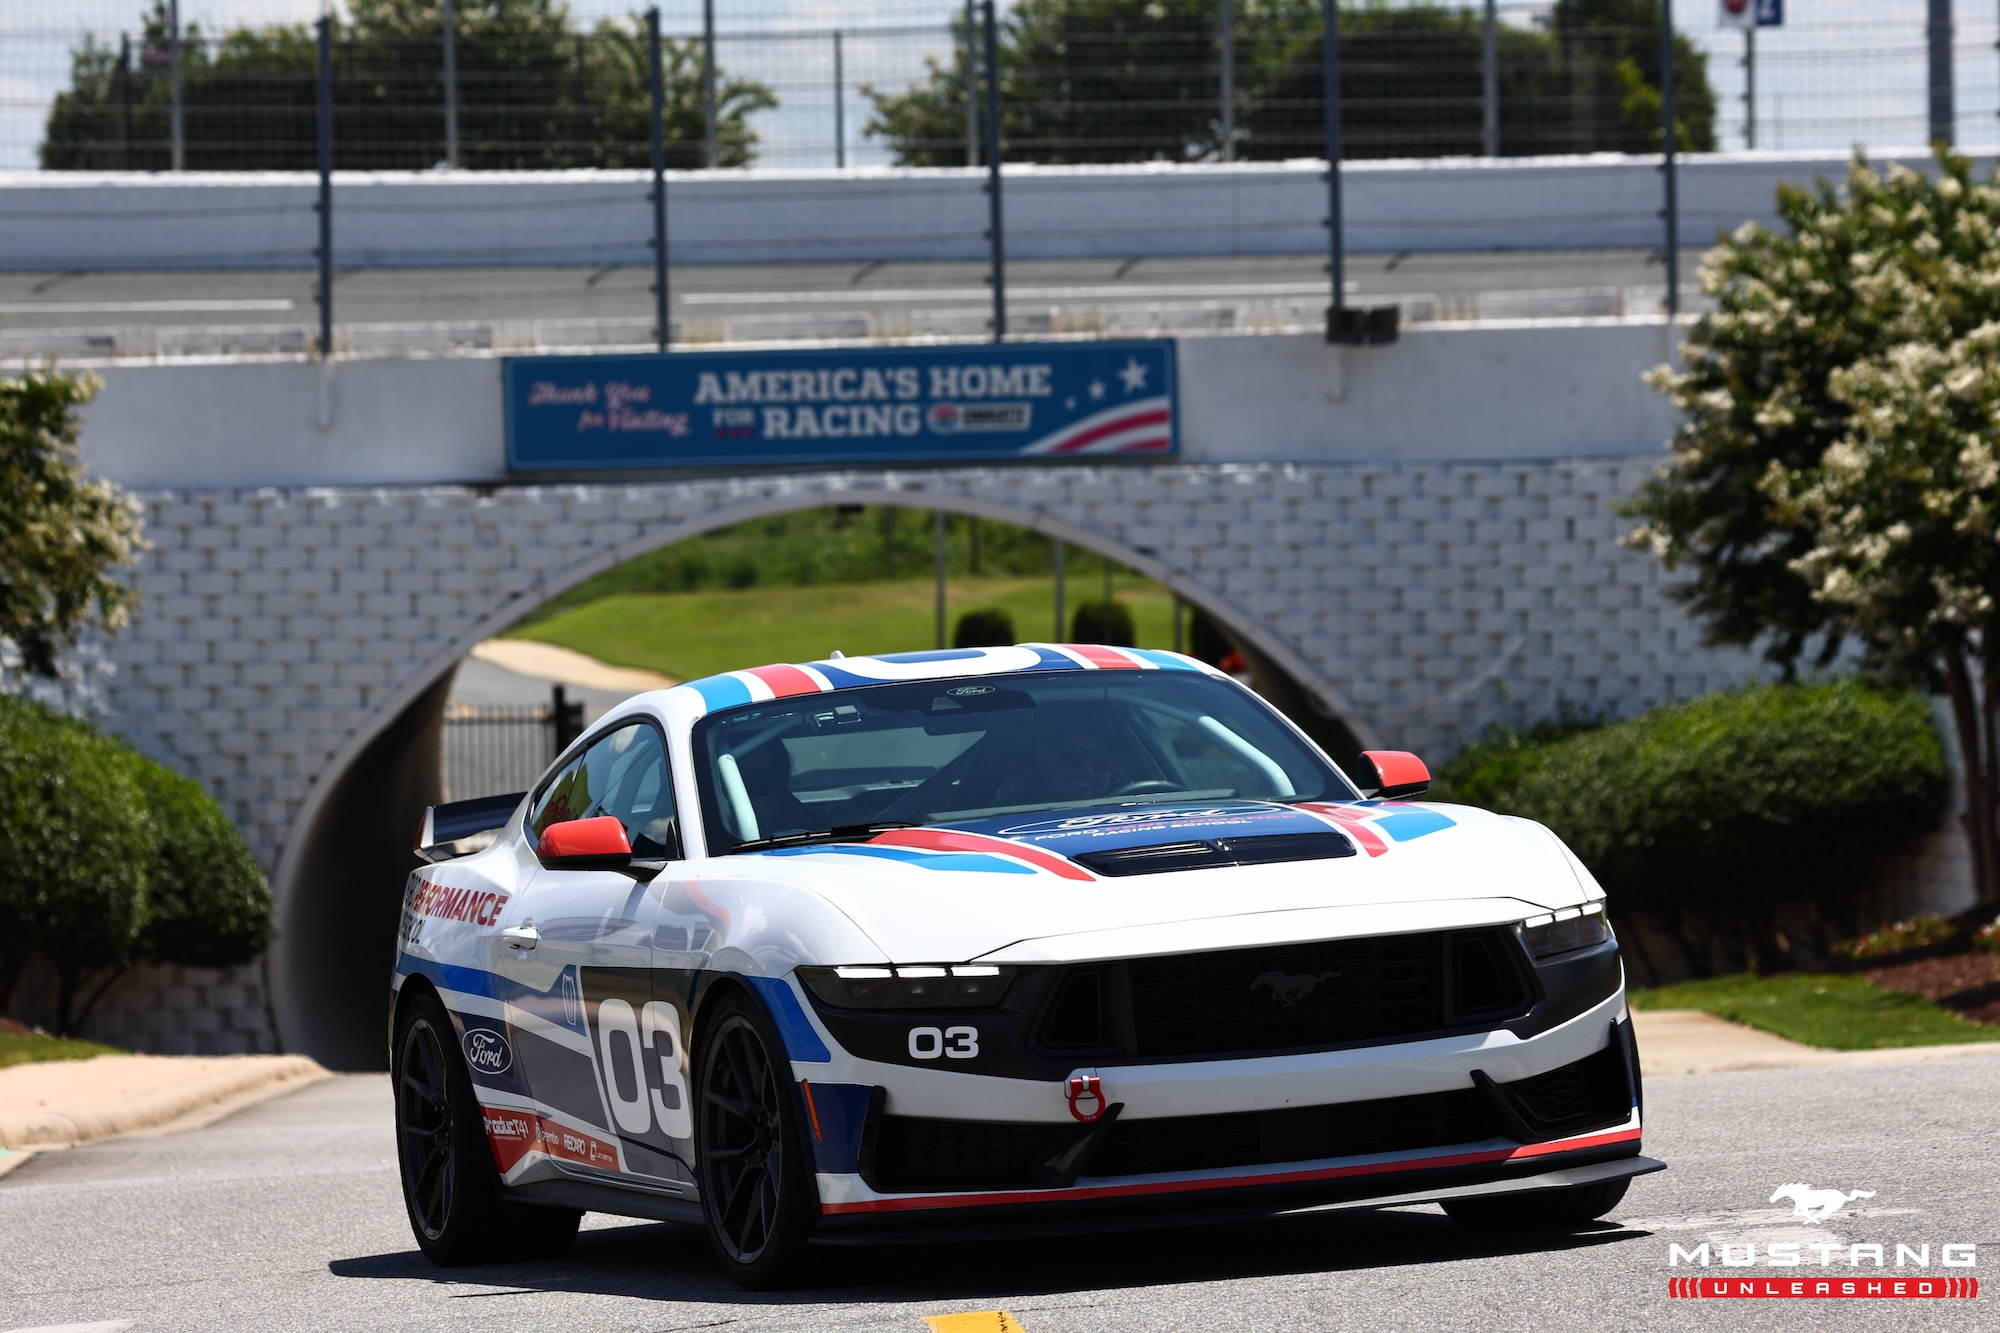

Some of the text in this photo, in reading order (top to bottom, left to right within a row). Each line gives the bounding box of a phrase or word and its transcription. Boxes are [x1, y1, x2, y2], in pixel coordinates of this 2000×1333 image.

[528, 380, 652, 408] Thank You
[695, 365, 1053, 404] AMERICA'S HOME
[712, 403, 921, 439] FOR RACING
[1034, 814, 1298, 842] FORD PERFORMANCE
[1057, 807, 1228, 829] Ford
[1092, 818, 1253, 837] RACING SCHOOL
[470, 1033, 504, 1069] Ford
[908, 1026, 980, 1060] 03
[598, 998, 695, 1139] 03
[563, 1133, 586, 1155] RECARO
